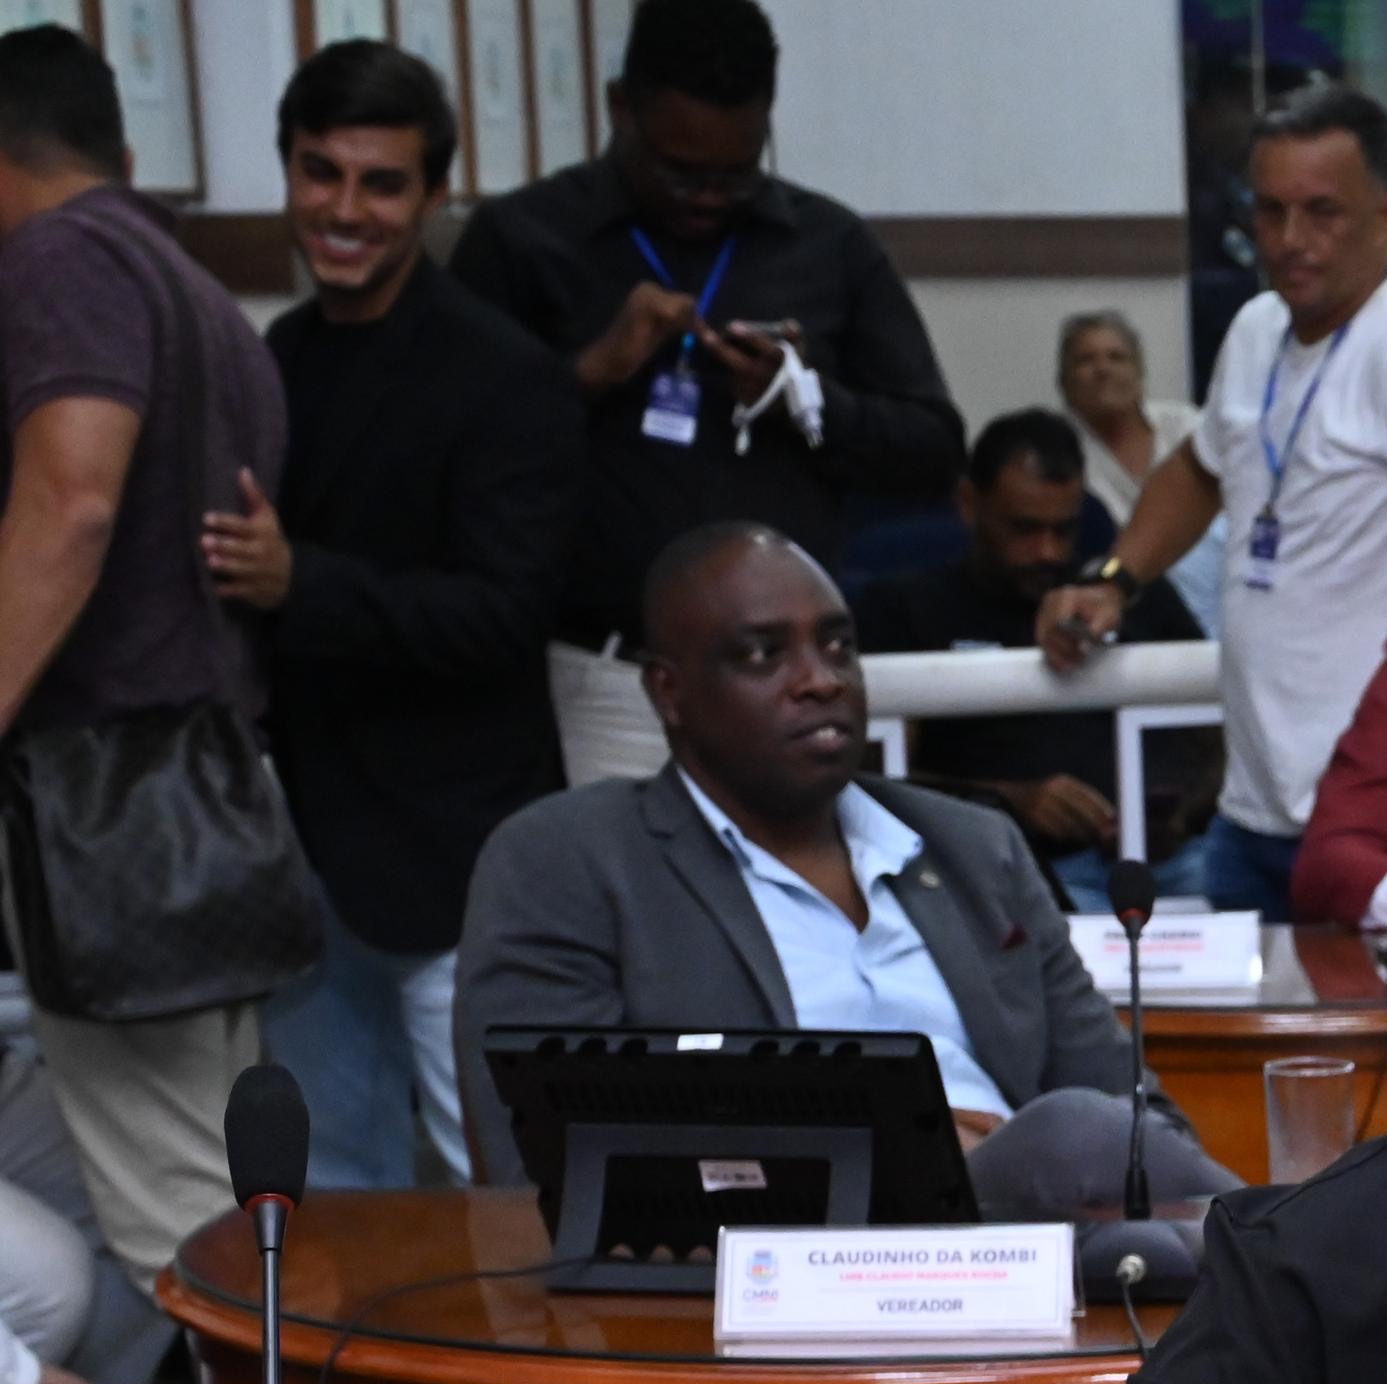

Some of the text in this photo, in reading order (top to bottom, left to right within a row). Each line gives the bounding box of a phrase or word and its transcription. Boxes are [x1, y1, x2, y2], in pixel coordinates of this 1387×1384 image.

[808, 1249, 1037, 1265] CLAUDINHO DA KOMBI
[877, 1298, 963, 1313] VEREADOR
